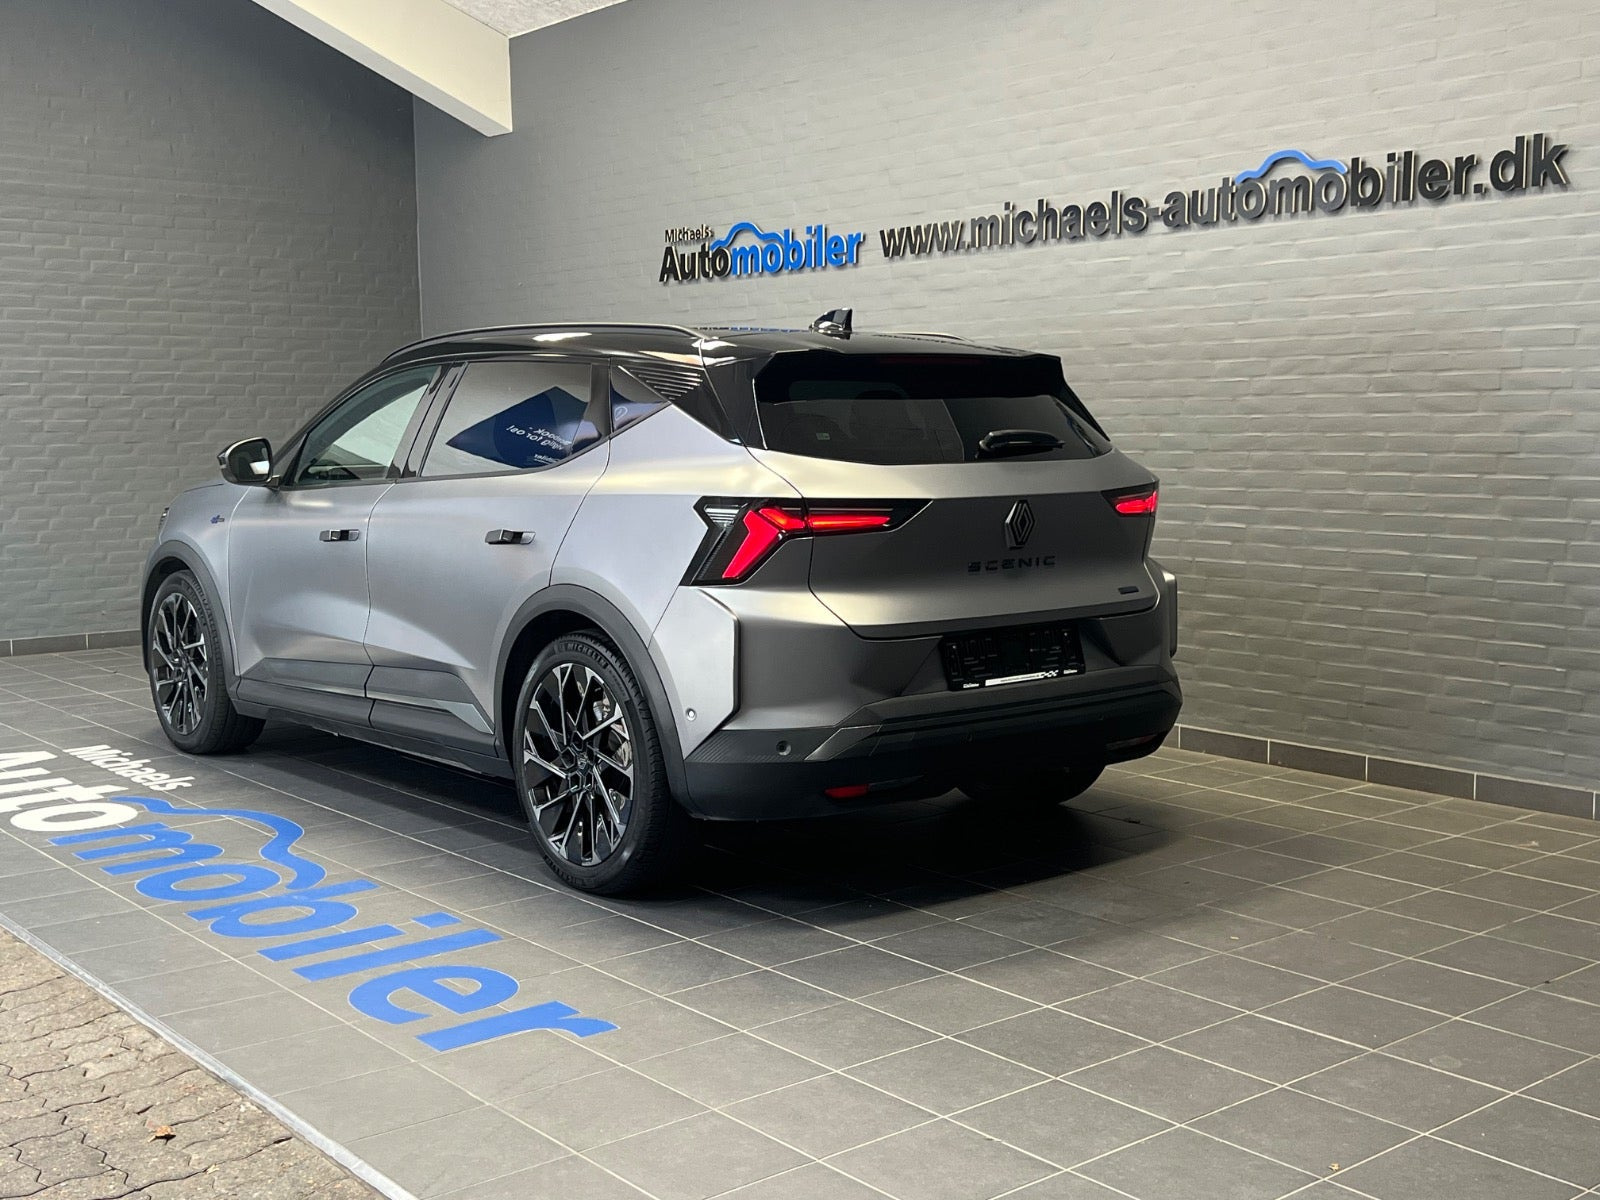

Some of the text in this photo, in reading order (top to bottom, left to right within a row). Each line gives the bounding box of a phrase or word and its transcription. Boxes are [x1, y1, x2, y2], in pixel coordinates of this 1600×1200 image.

[879, 132, 1569, 258] www.michaels-automobiler.dk
[665, 224, 713, 243] Michaels
[659, 224, 864, 283] Automobiler
[967, 555, 1056, 573] SCENIC
[567, 641, 609, 669] MICHELIN
[62, 744, 196, 792] Michaels
